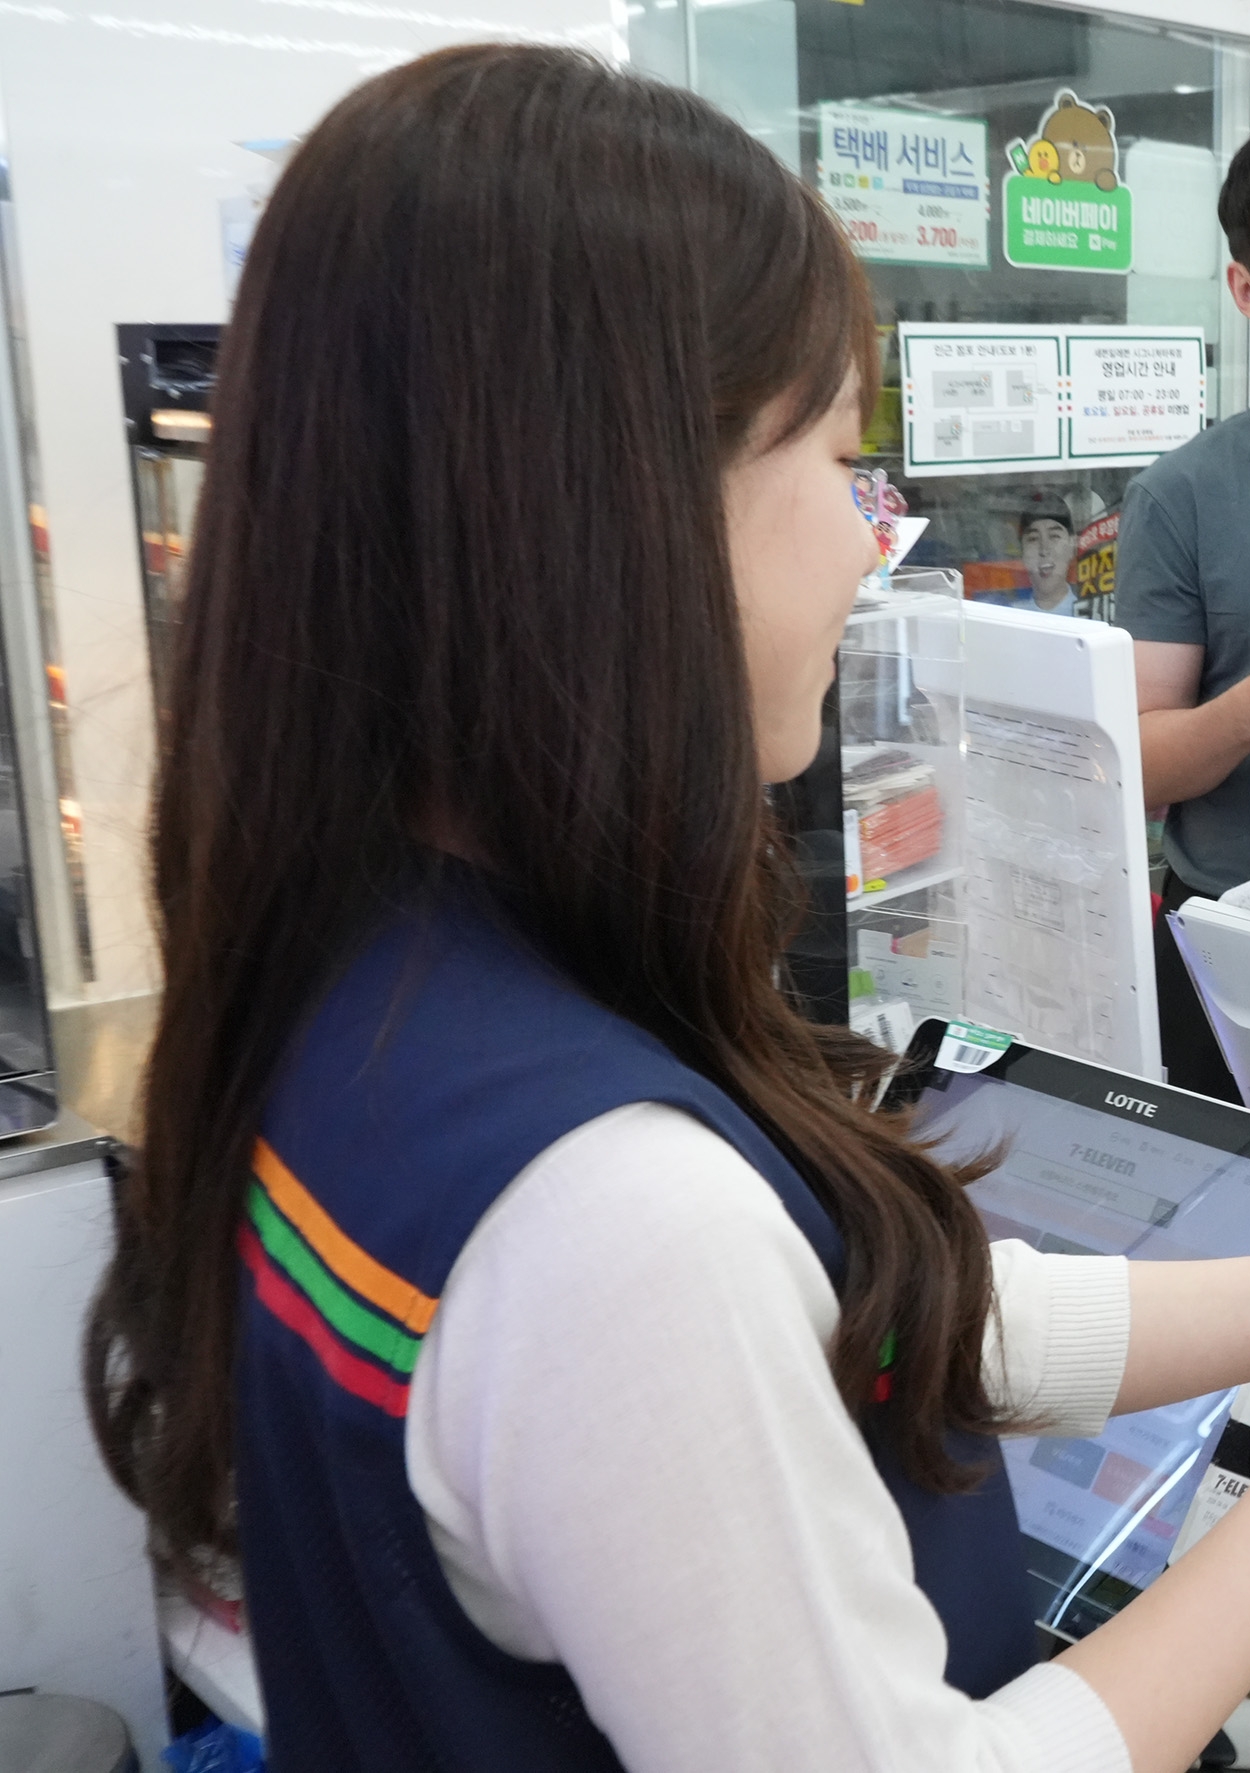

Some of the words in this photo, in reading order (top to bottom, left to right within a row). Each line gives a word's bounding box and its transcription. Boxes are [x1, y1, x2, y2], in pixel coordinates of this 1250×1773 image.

[834, 127, 888, 172] 택배
[896, 134, 975, 177] 서비스
[1022, 196, 1118, 232] 네이버페이
[1023, 229, 1078, 248] 결제하세요
[1102, 362, 1148, 378] 영업시간
[1153, 362, 1176, 377] 안내
[1098, 390, 1115, 401] 평일
[1104, 1091, 1158, 1118] LOTTE
[1214, 1474, 1249, 1498] 7-ELE
